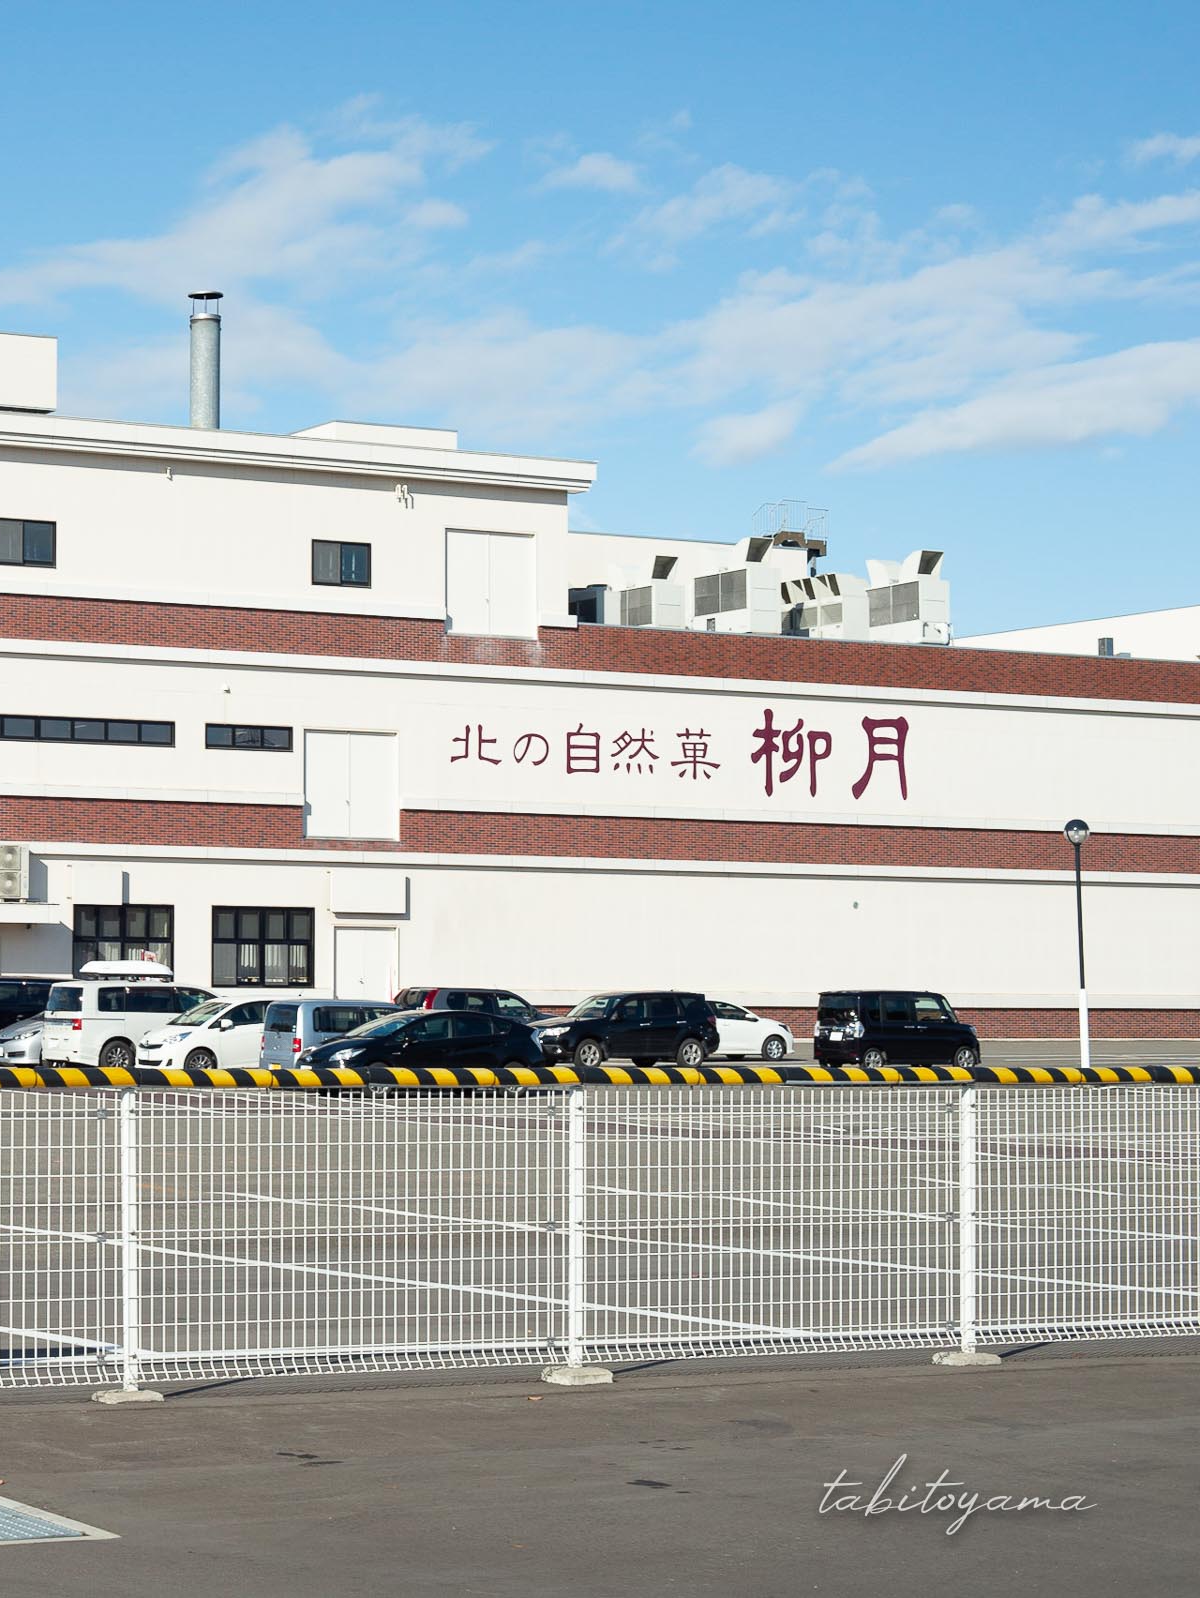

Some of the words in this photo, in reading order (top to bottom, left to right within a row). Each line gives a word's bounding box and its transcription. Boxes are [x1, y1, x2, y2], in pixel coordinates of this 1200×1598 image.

[450, 722, 721, 781] 北の自然菓
[750, 708, 910, 801] 柳月
